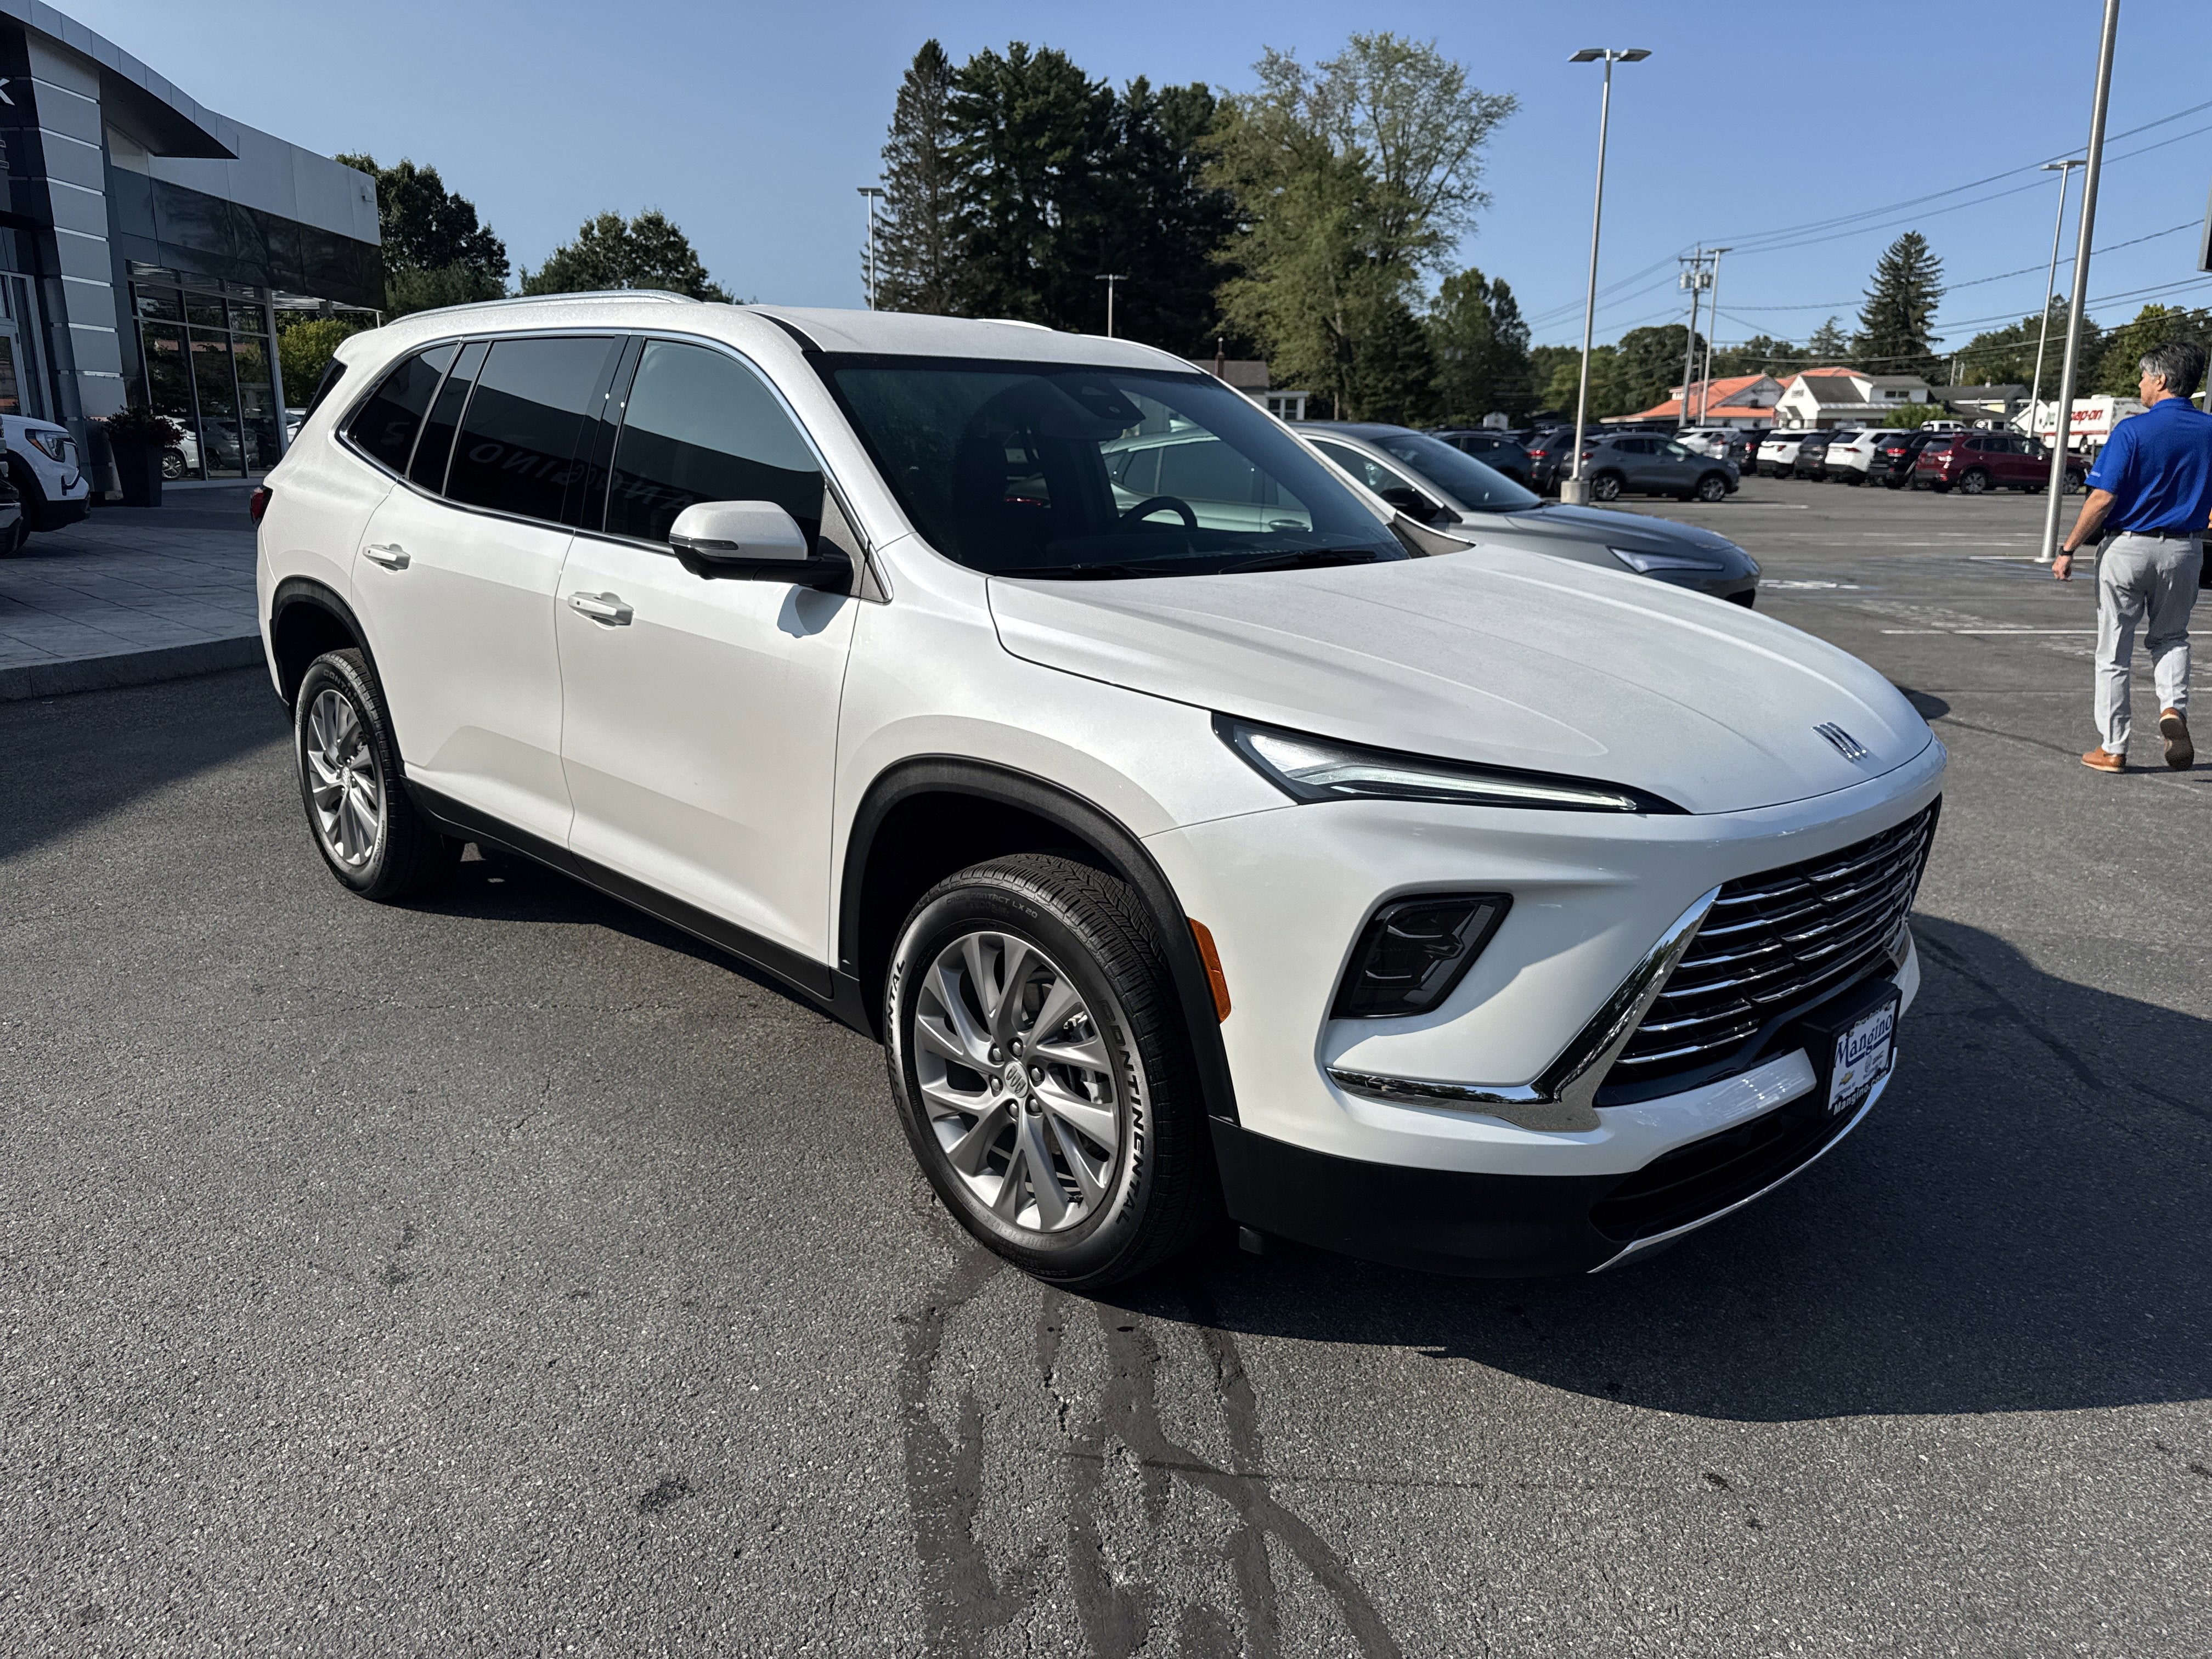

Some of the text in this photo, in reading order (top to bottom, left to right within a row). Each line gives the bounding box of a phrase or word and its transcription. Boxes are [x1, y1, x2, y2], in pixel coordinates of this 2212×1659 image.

[1835, 1014, 1892, 1068] Mangino
[1099, 998, 1144, 1227] CONTINENTAL
[1833, 1070, 1887, 1116] Mangino.com
